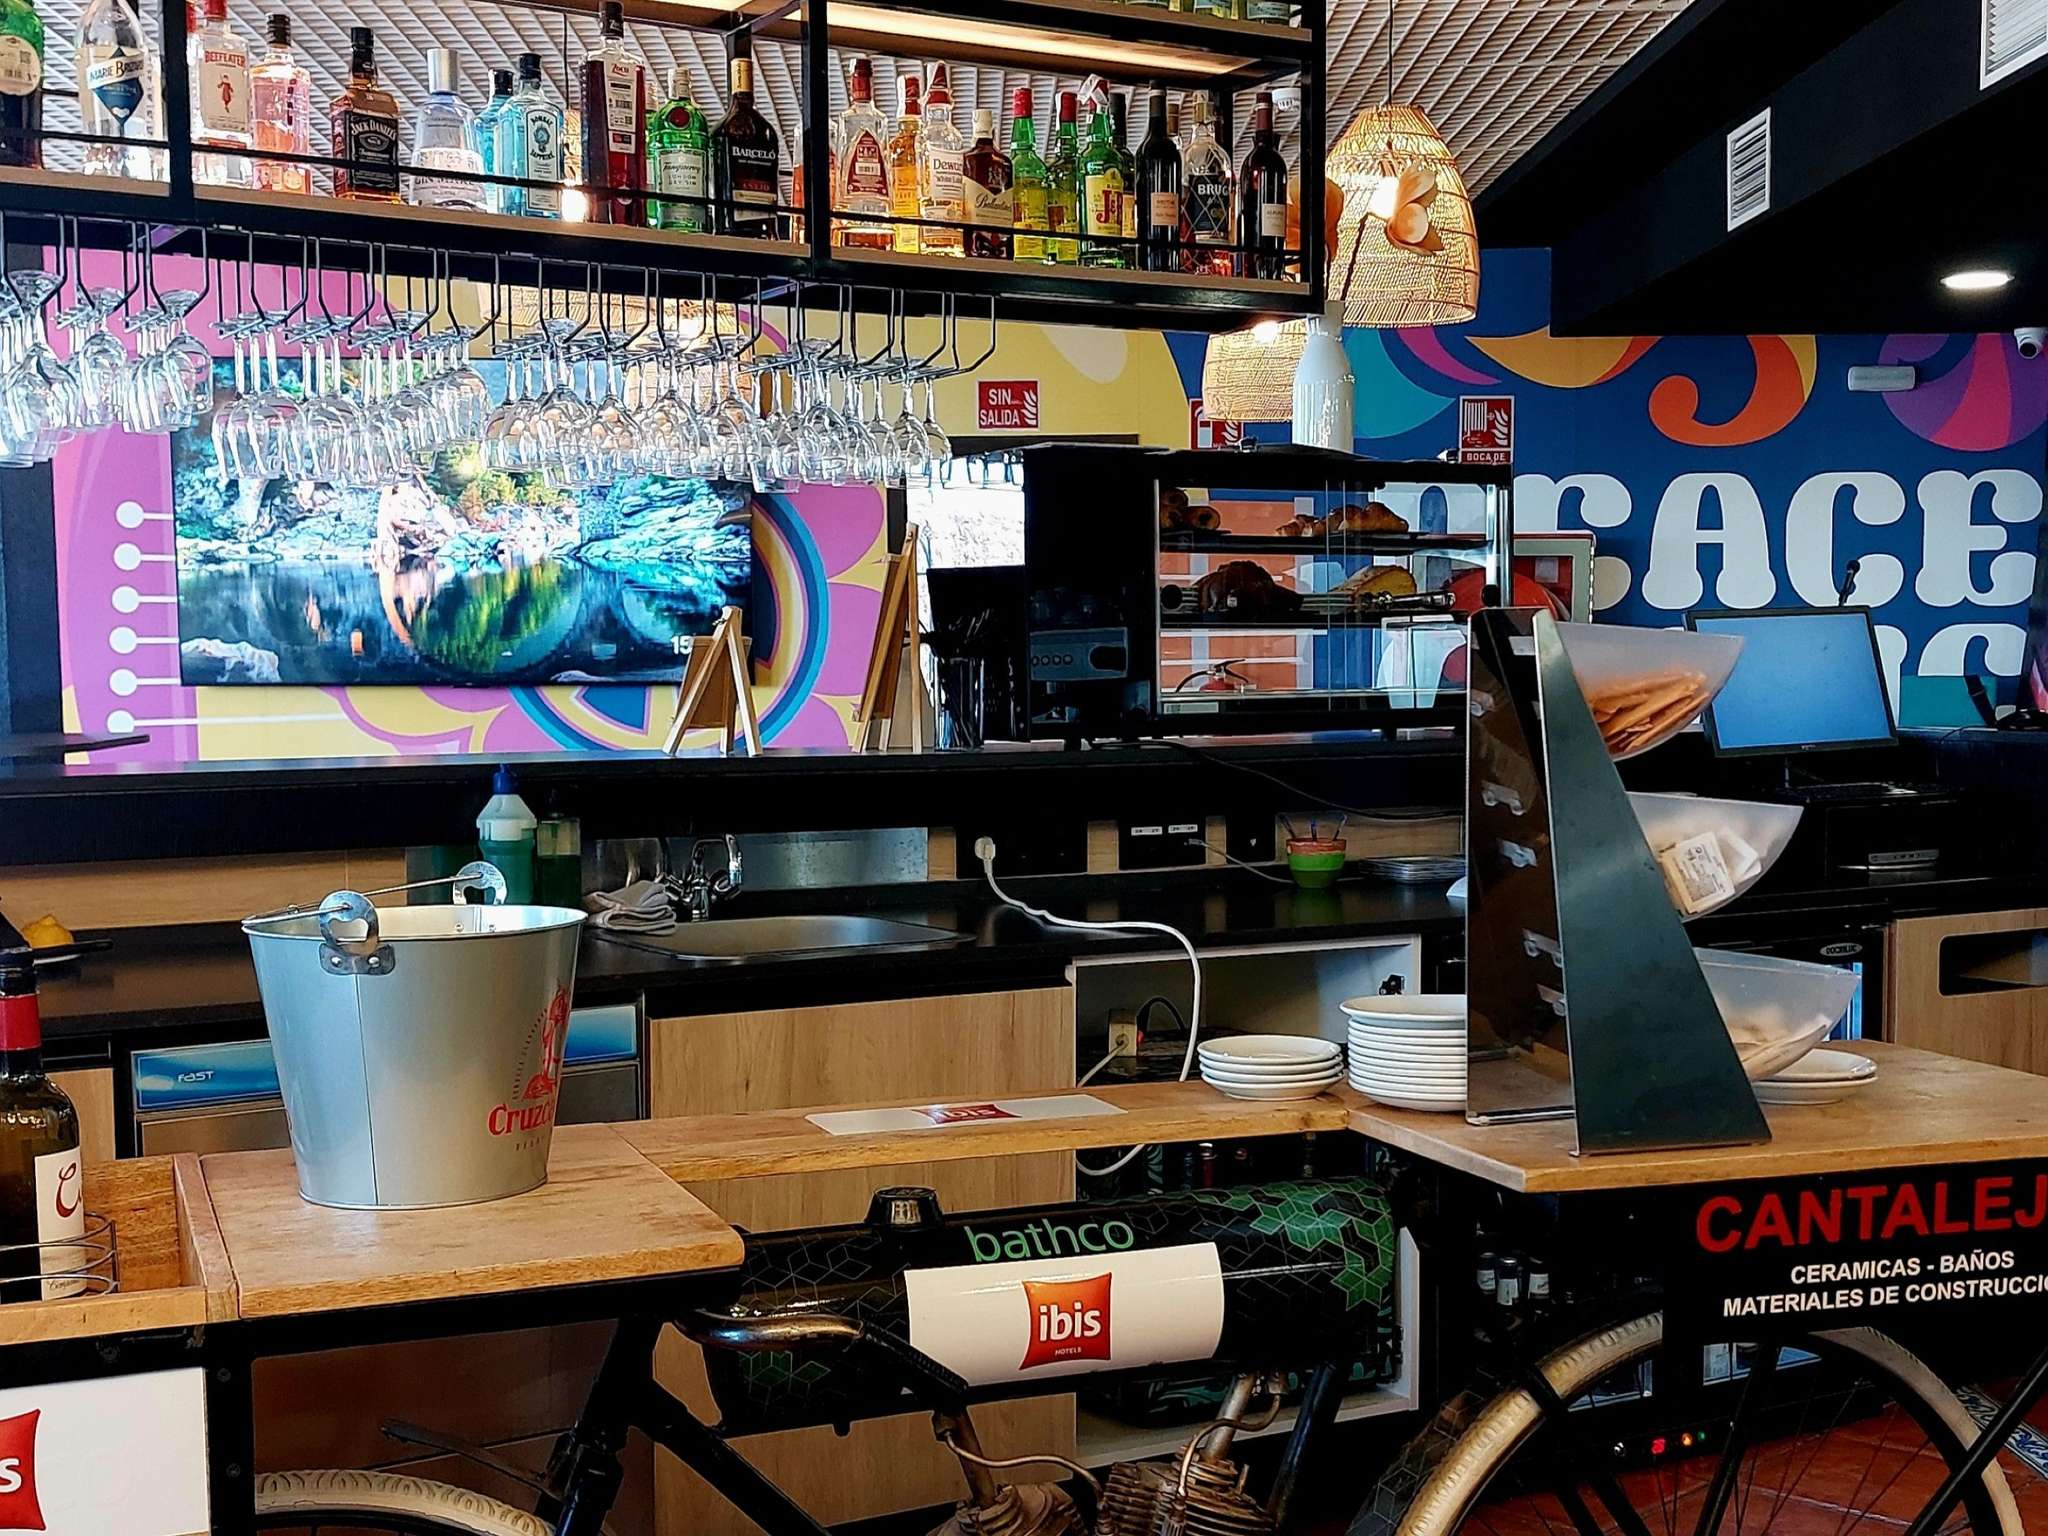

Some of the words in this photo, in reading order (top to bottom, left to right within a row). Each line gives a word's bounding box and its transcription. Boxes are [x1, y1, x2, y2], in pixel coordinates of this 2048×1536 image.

[732, 146, 776, 160] BARCELÓ
[988, 388, 1011, 405] SIN
[979, 409, 1020, 426] SALIDA
[963, 1218, 1134, 1263] bathco
[1790, 1257, 1921, 1285] CERAMICAS
[1939, 1249, 2015, 1274] BAÑOS
[1723, 1288, 1864, 1318] MATERIALES
[1869, 1285, 1900, 1307] DE
[1039, 1301, 1102, 1342] ibis
[1055, 1346, 1082, 1356] HOTELS
